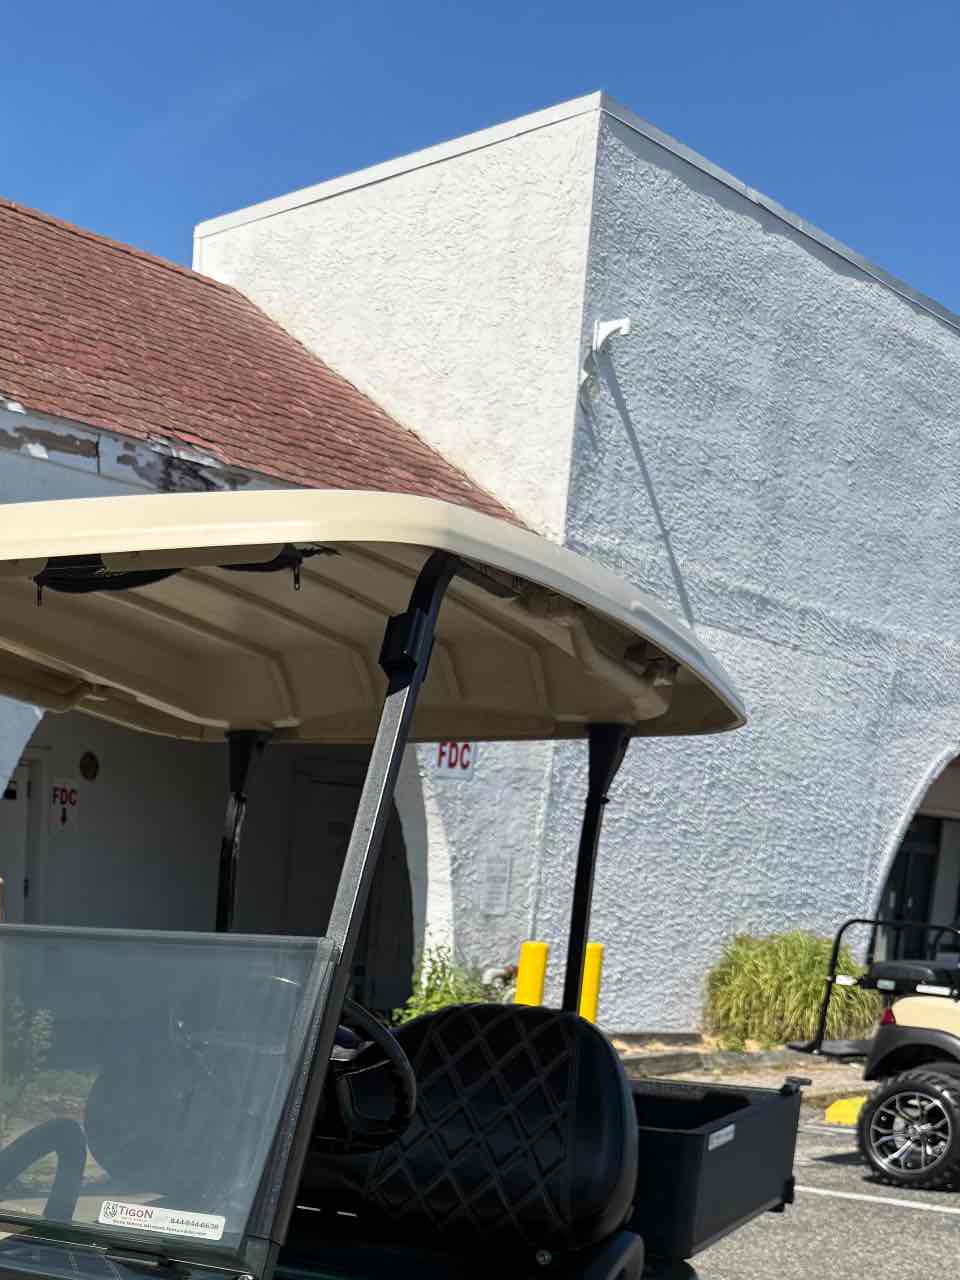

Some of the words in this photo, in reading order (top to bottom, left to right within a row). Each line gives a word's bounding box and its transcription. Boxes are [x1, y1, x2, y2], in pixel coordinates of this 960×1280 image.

[437, 740, 471, 770] FDC
[52, 786, 79, 806] FDC
[119, 1205, 154, 1219] TIGON
